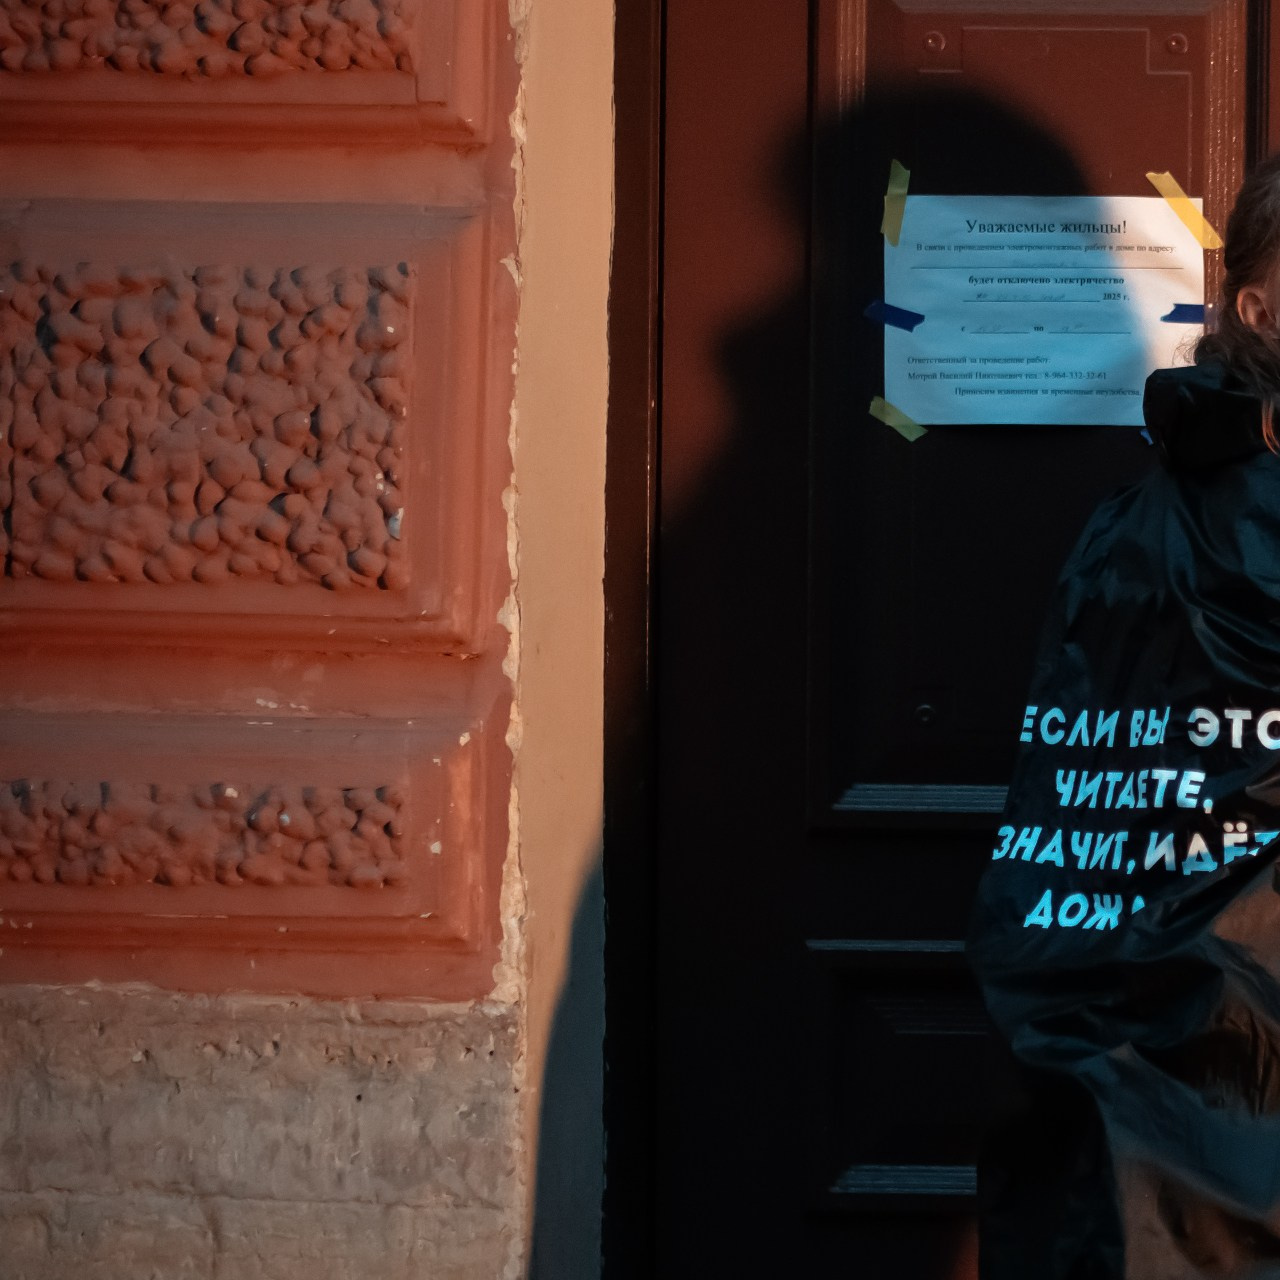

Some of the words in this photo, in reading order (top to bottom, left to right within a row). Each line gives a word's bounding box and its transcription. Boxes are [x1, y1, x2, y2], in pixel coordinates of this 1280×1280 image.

[965, 219, 1056, 235] Уважаемые
[1060, 220, 1128, 236] жильцы!
[1084, 243, 1107, 253] работ
[968, 275, 994, 286] будет
[997, 276, 1051, 284] отключено
[1053, 277, 1125, 287] электричество
[1102, 292, 1122, 301] 2025
[1020, 705, 1120, 747] ЕСЛИ
[1129, 706, 1171, 747] ВЫ
[1055, 769, 1213, 814] ЧИТАЕТЕ,
[992, 825, 1136, 875] ЗНАЧИТ,
